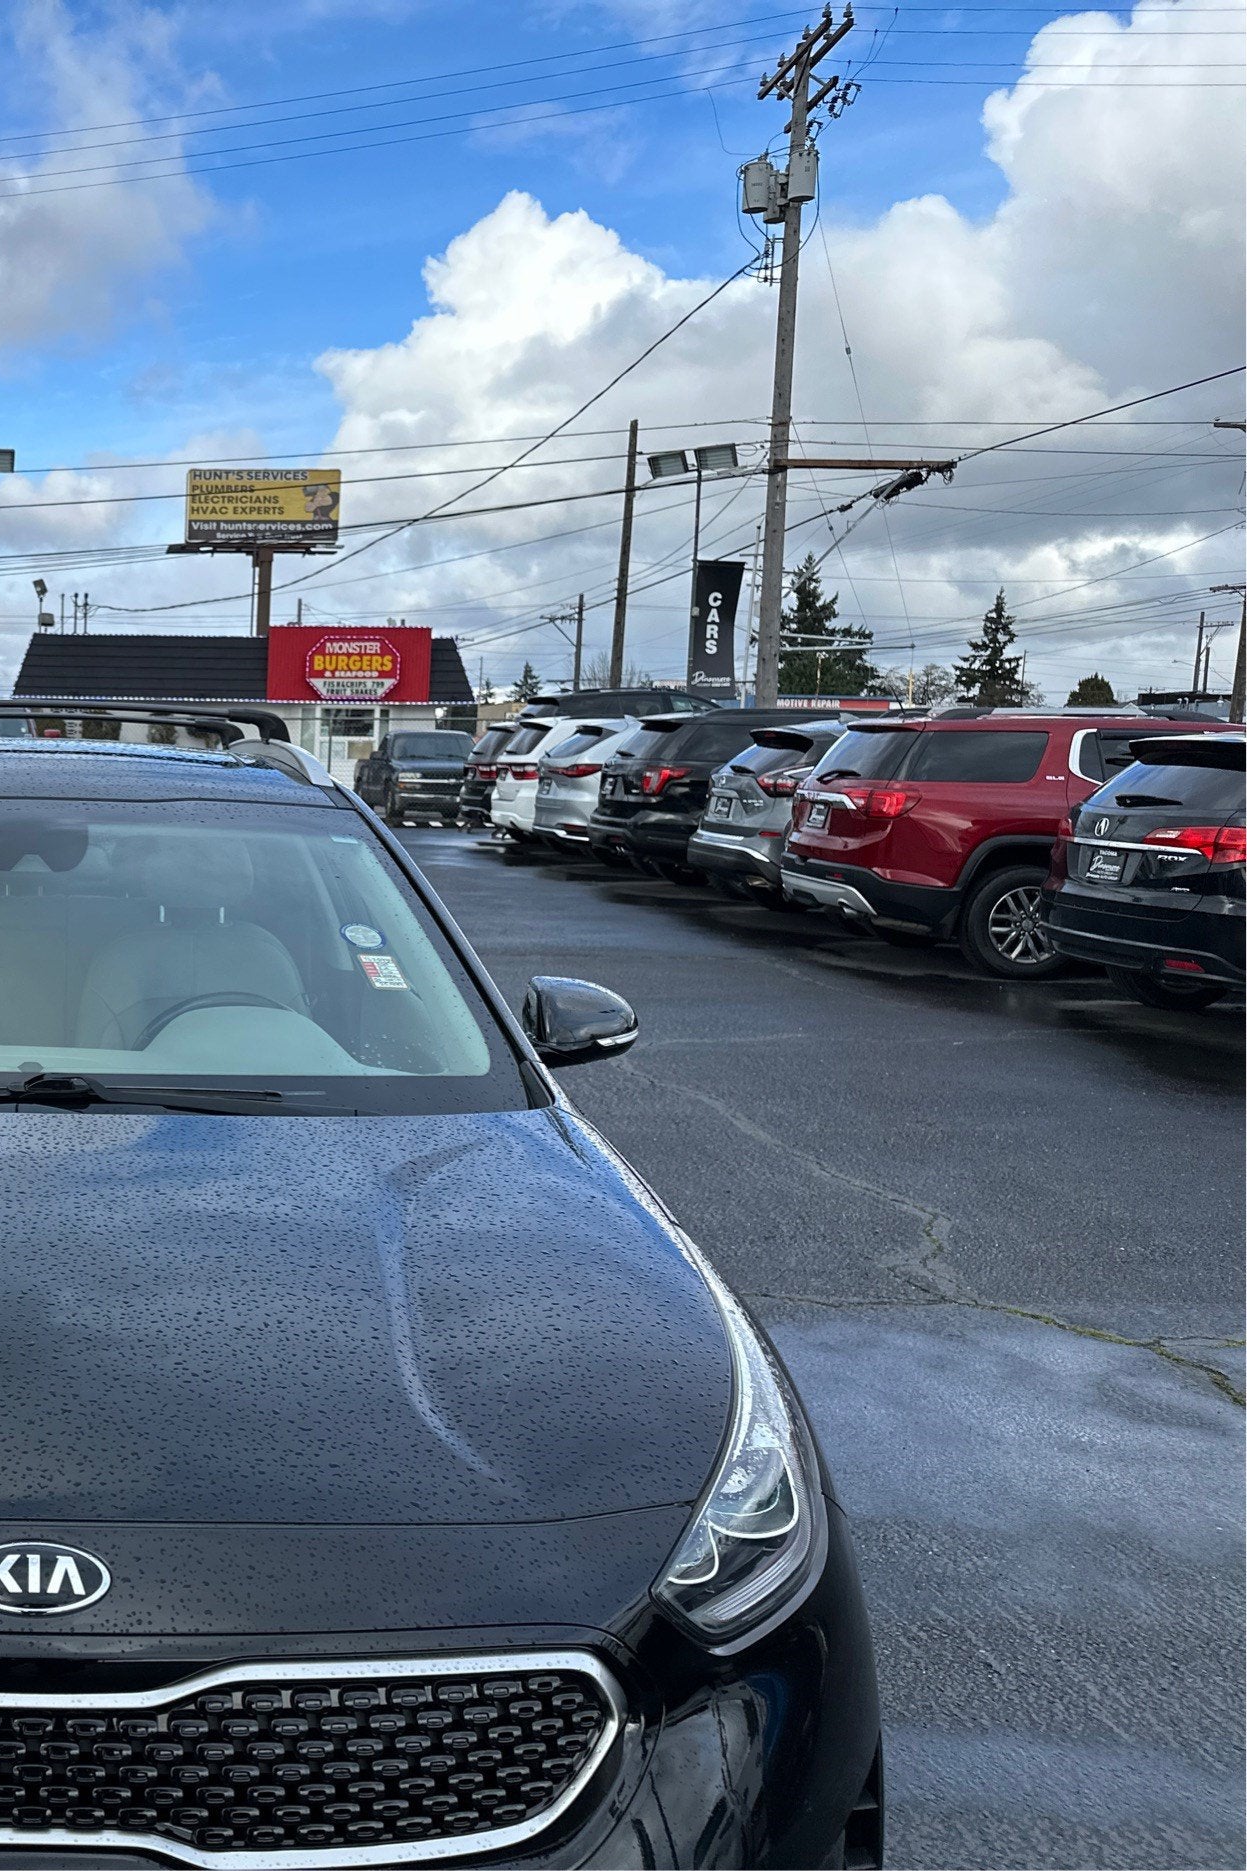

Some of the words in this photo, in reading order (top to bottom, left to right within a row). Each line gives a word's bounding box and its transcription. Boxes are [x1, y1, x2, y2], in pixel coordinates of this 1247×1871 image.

[193, 470, 244, 481] HUNT'S
[247, 470, 308, 481] SERVICES
[192, 484, 255, 494] PLUMBERS
[192, 495, 280, 504] ELECTRICIANS
[191, 506, 229, 515] HVAC
[233, 506, 285, 515] EXPERTS
[191, 521, 217, 531] Visit
[705, 591, 723, 655] CARS
[325, 642, 381, 654] MONSTER
[313, 655, 393, 671] BURGERS
[326, 688, 347, 696] FRUIT
[350, 688, 378, 696] SHAKES
[776, 698, 808, 708] MOTIVE
[811, 699, 841, 709] REPAIR
